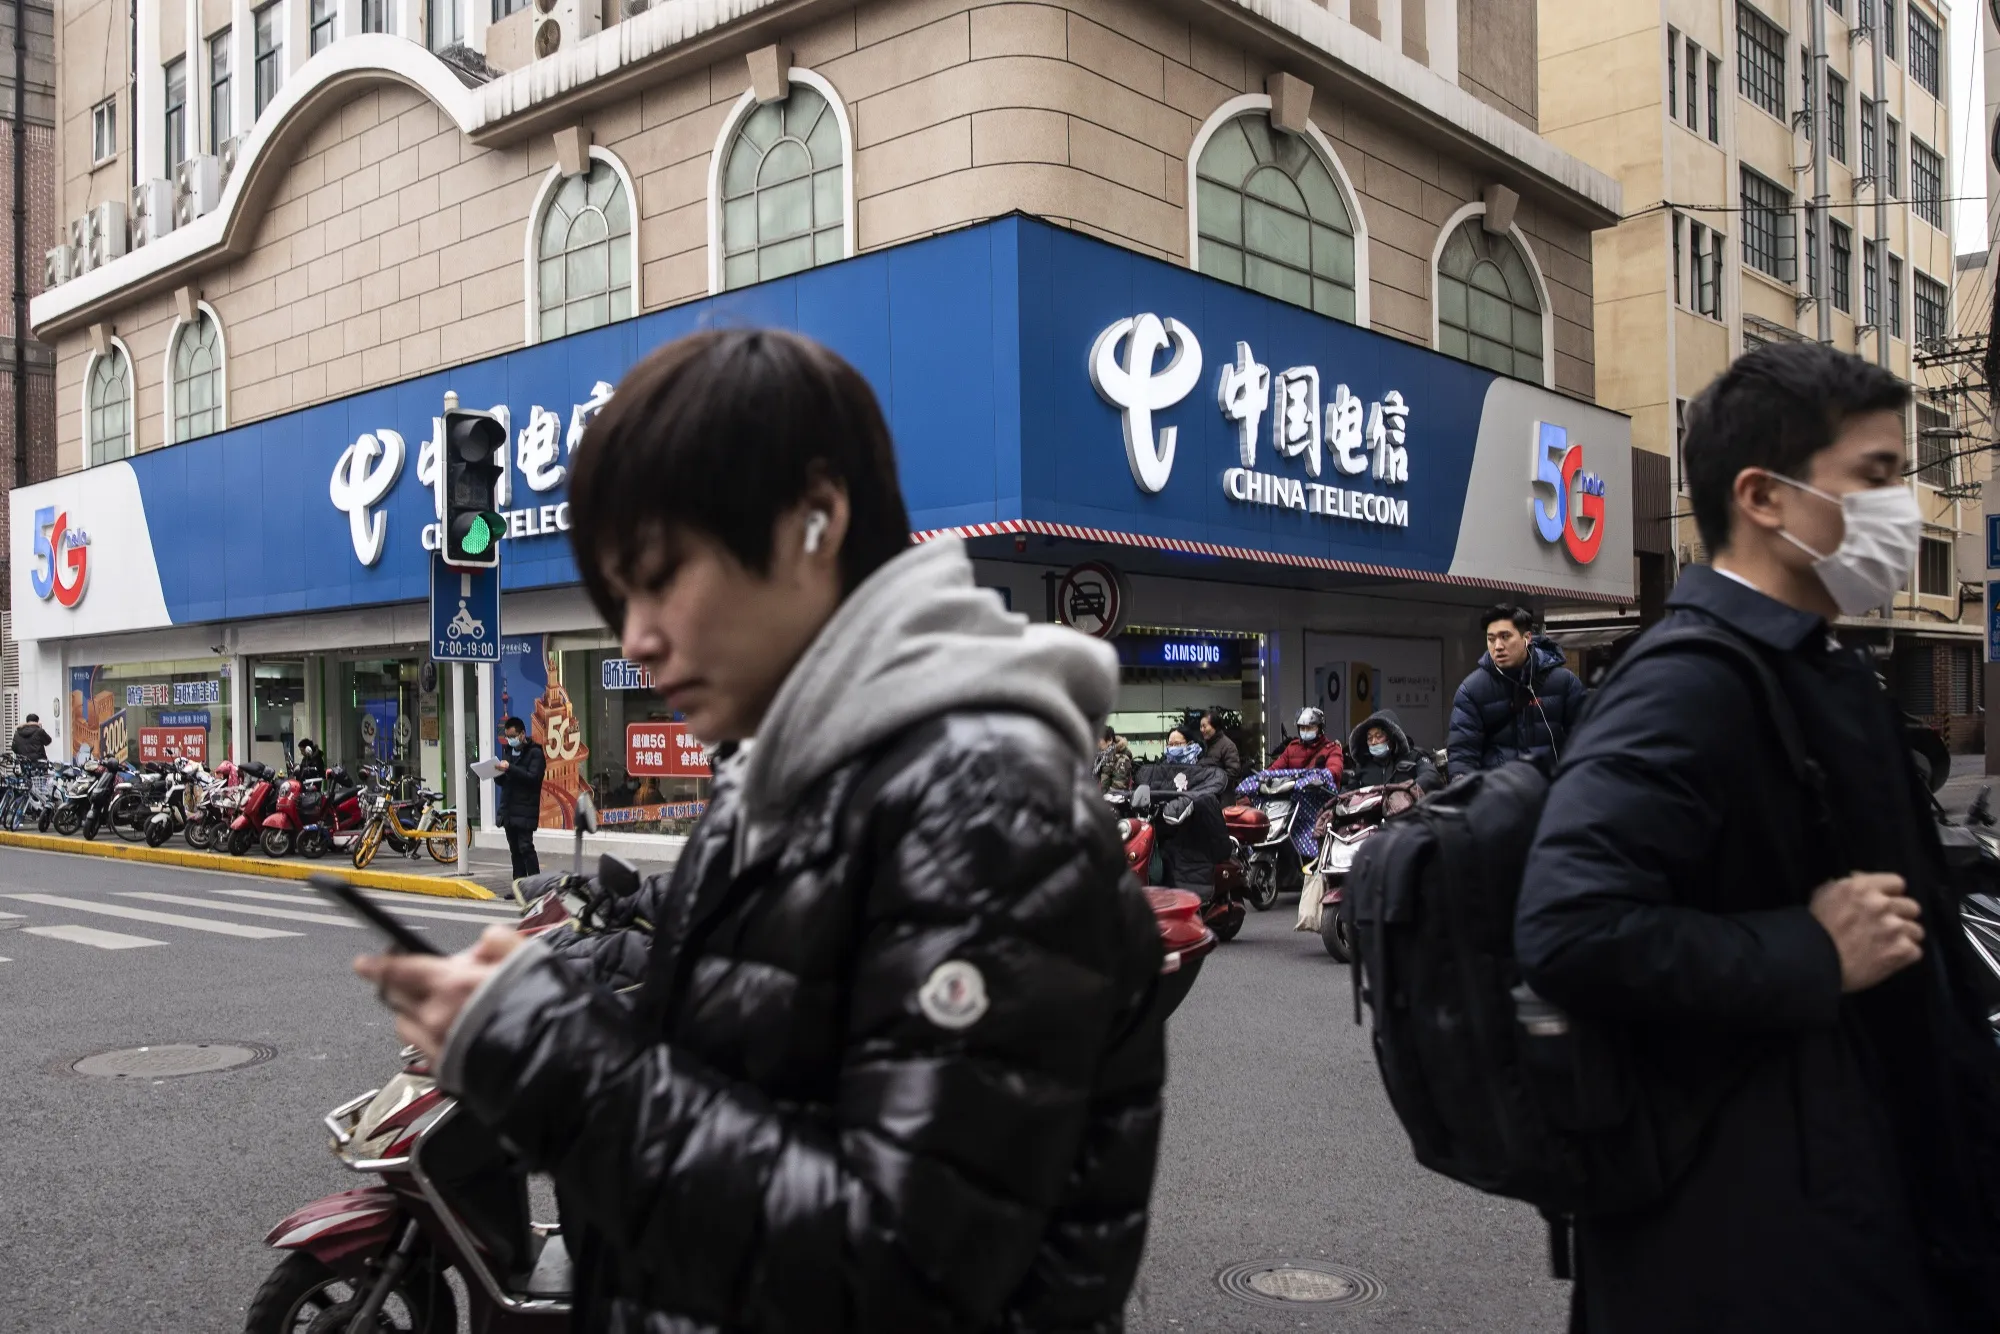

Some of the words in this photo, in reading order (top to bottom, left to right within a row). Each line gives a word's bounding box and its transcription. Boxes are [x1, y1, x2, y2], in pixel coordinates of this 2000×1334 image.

[1218, 341, 1409, 484] 中国电信
[1528, 421, 1605, 564] 5G
[1582, 468, 1605, 497] hello
[1223, 468, 1307, 511] CHINA
[1306, 482, 1409, 527] TELECOM
[30, 505, 88, 608] 5G
[438, 640, 494, 657] 7:00-19:00
[1164, 643, 1220, 663] SAMSUNG
[173, 680, 219, 705] 互联新生活
[546, 715, 580, 760] 5G
[632, 733, 666, 748] 超值5G
[635, 751, 663, 766] 升级包
[681, 751, 711, 766] 会员权
